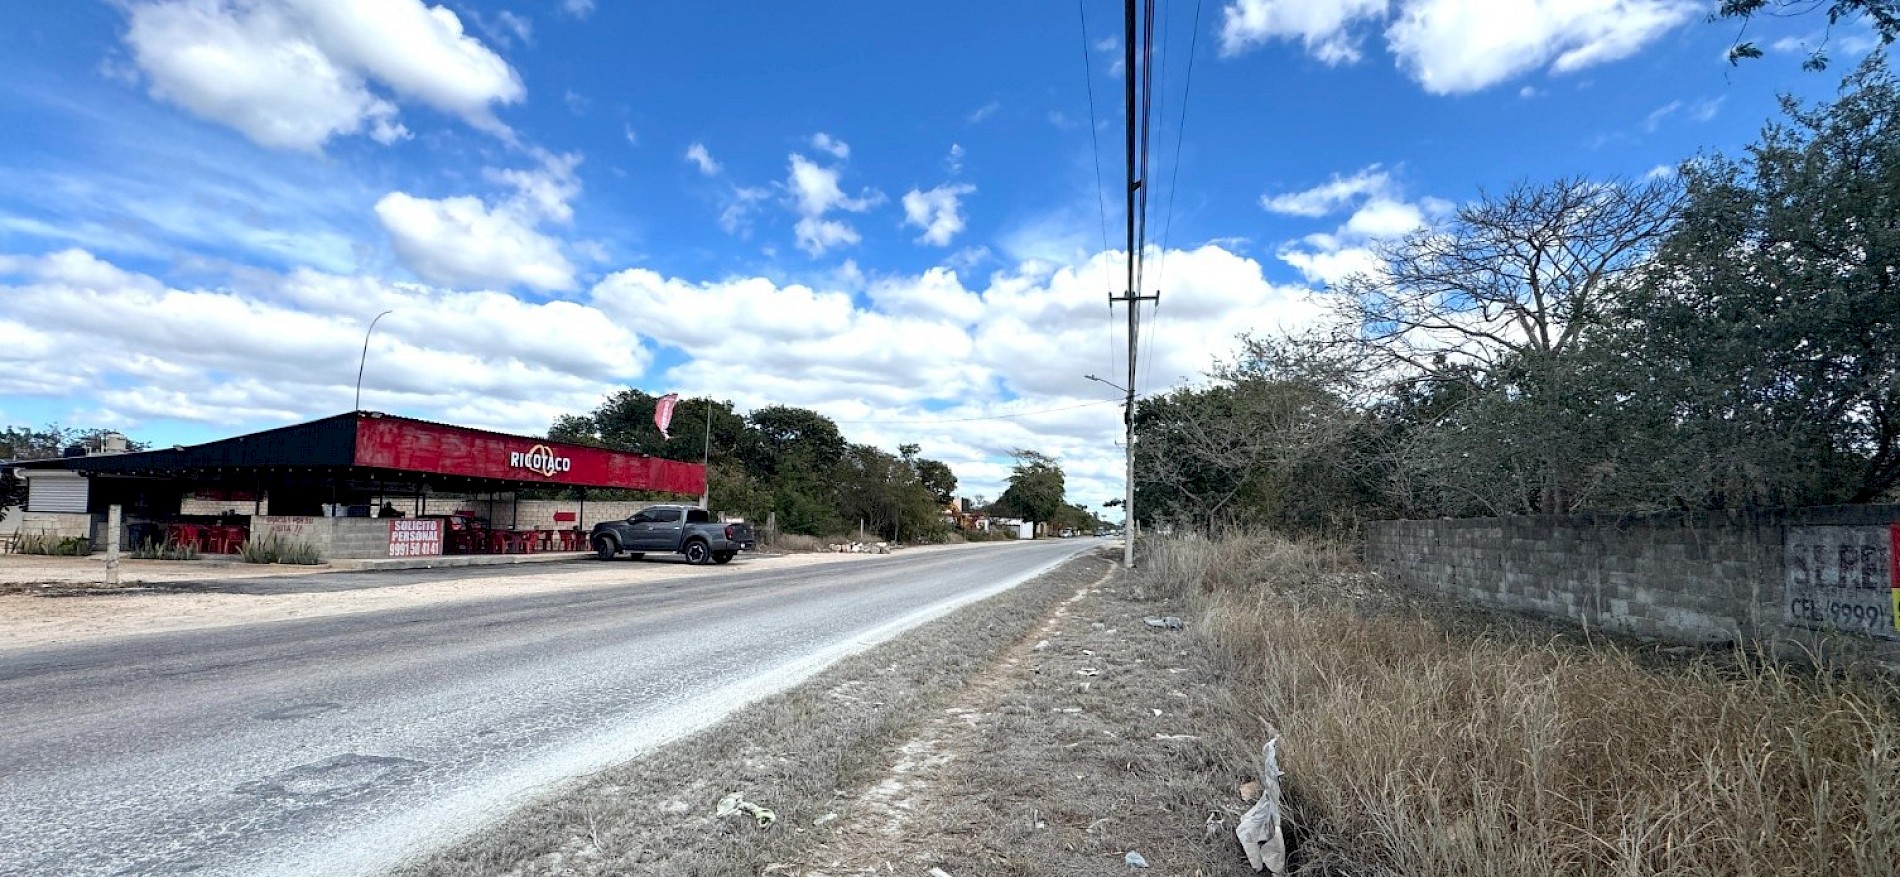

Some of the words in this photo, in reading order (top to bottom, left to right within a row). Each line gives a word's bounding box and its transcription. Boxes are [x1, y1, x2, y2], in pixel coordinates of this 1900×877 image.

[510, 451, 571, 472] RICOTACO
[394, 520, 438, 531] SOLICITO
[391, 530, 438, 542] PERSONAL
